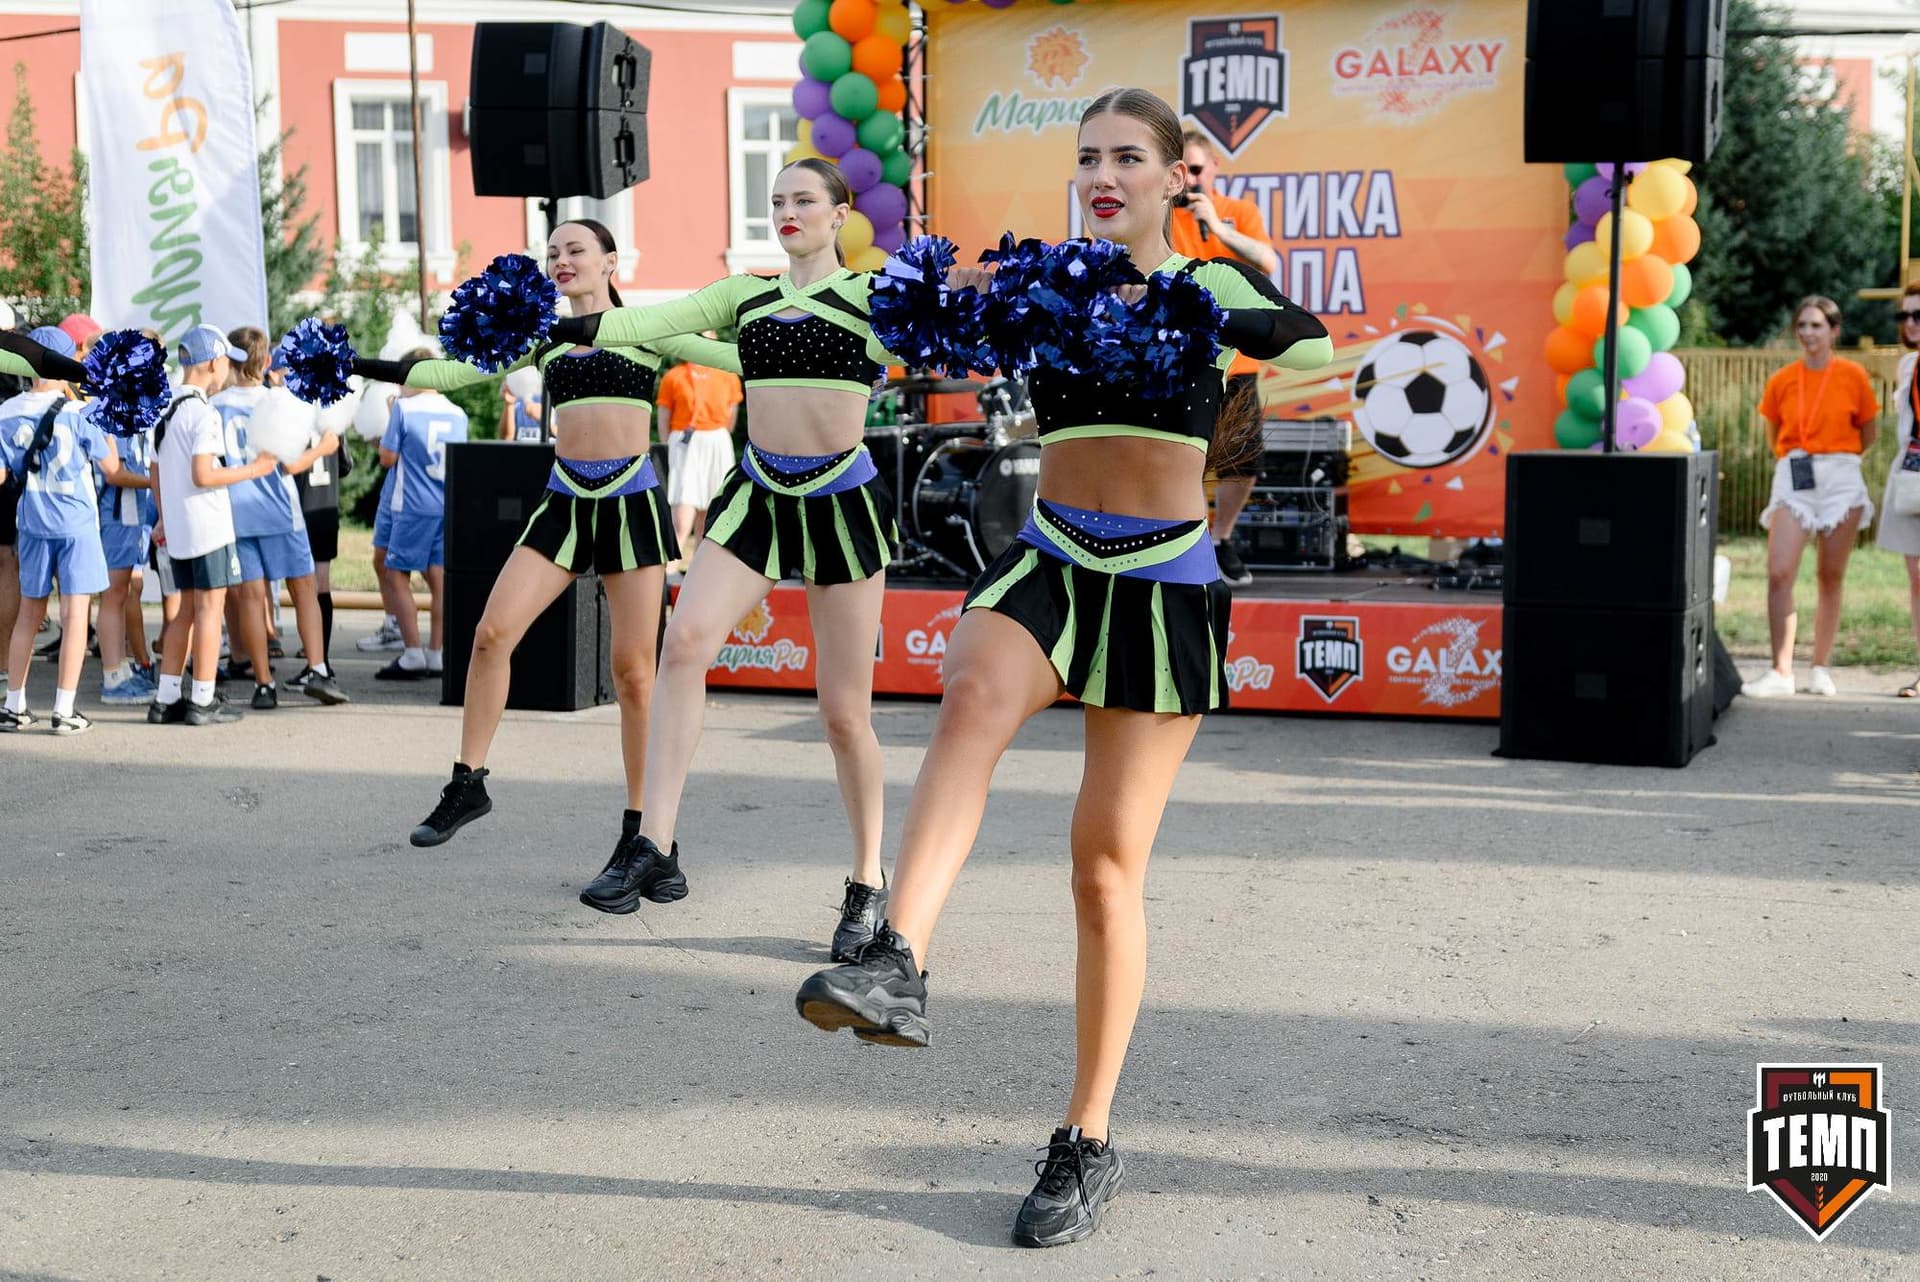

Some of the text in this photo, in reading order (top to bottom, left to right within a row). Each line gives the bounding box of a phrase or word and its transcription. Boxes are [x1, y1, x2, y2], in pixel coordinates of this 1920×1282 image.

[1335, 43, 1502, 79] GALAXY
[1188, 54, 1279, 107] ТЕМП
[711, 642, 804, 670] арияРа
[1303, 639, 1357, 671] ТЕМП
[1387, 646, 1502, 676] GALAX
